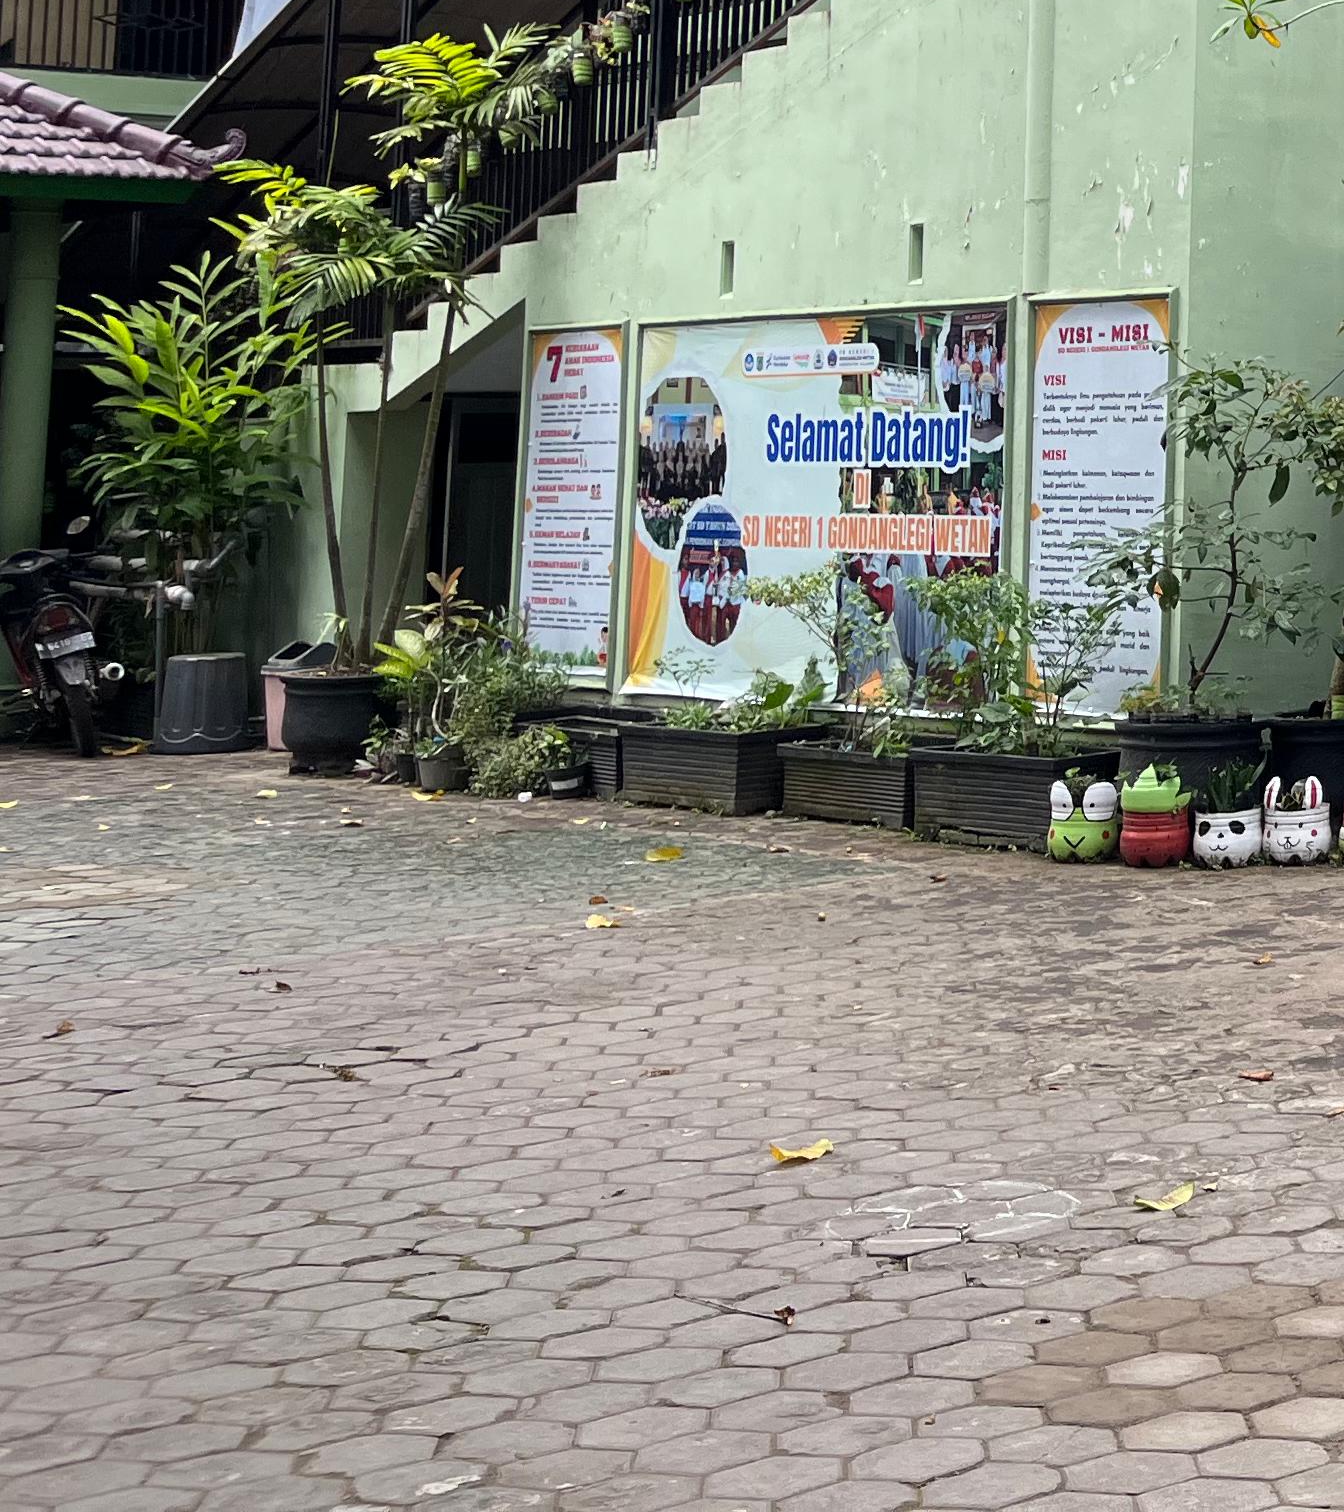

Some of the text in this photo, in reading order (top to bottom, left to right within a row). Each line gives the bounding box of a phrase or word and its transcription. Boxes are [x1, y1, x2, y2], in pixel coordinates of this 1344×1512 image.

[1059, 326, 1093, 345] VISI
[1111, 324, 1149, 342] MISI
[547, 345, 563, 382] 7
[1044, 375, 1067, 386] VISI
[767, 410, 969, 468] Selamat Datang!
[1042, 449, 1067, 460] MISI
[856, 472, 870, 506] DI
[743, 515, 990, 553] SD NEGERI 1 GONDANGLEGI WETAN
